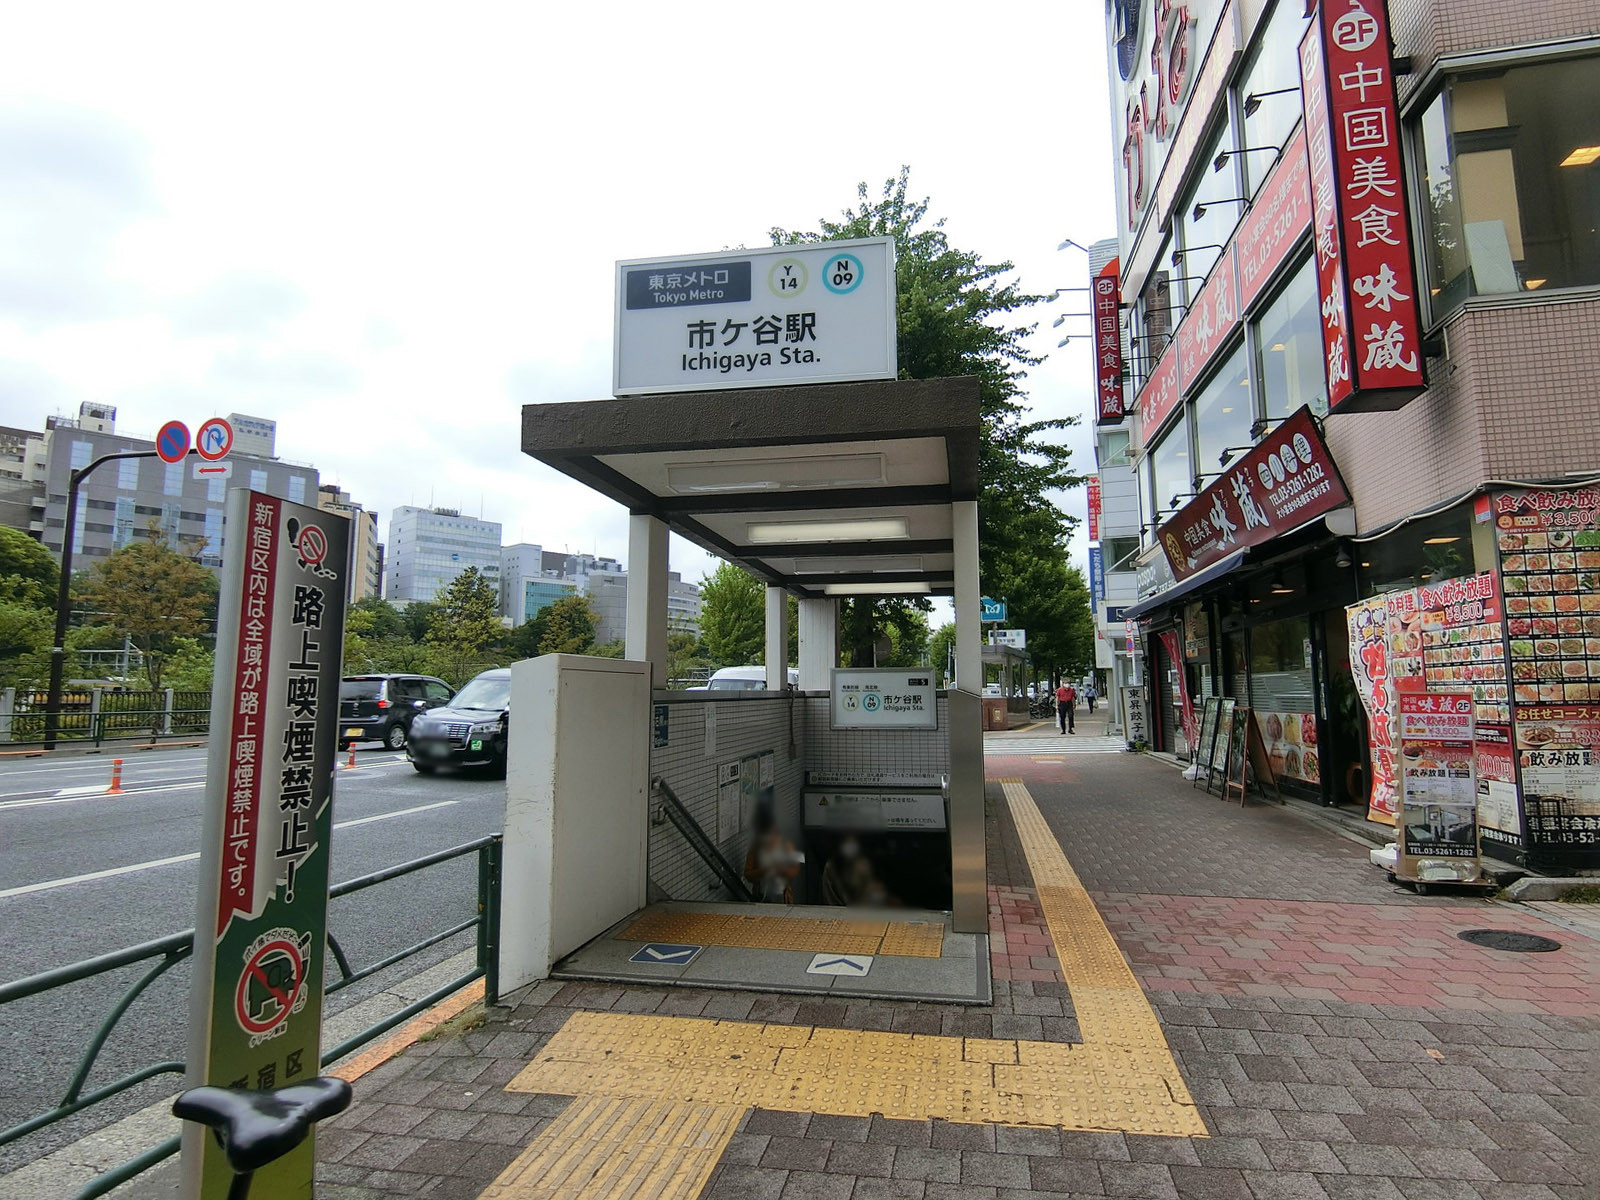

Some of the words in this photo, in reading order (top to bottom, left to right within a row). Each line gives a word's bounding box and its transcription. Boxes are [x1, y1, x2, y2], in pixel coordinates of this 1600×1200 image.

[1338, 19, 1373, 45] 2F
[1338, 62, 1400, 248] 中国美食
[1306, 83, 1337, 271] 中国美食
[783, 265, 793, 276] Y
[836, 260, 849, 272] N
[648, 269, 729, 290] 東京メトロ
[780, 277, 798, 290] 14
[832, 272, 853, 286] 09
[1098, 282, 1113, 292] 2F
[653, 291, 687, 305] Tokyo
[689, 288, 724, 301] Metro
[1196, 269, 1233, 356] 味蔵
[1352, 263, 1418, 372] 味蔵
[1098, 298, 1118, 369] 中国美食
[1321, 279, 1349, 390] 味蔵
[681, 351, 771, 374] Ichigaya
[780, 346, 821, 366] Sta.
[1100, 376, 1123, 415] 味蔵
[1209, 469, 1270, 546] 味蔵
[1498, 489, 1600, 513] 食べ飲み放
[1183, 518, 1213, 548] 中国美食
[1421, 574, 1493, 610] 食べ飲み放題
[228, 502, 273, 897] 新宿区内は全域が路上喫煙禁止です。
[883, 704, 911, 712] Ichigaya
[1417, 696, 1457, 714] 味蔵
[1457, 702, 1469, 711] 2F
[1405, 714, 1470, 727] 食べ飲み放題
[1410, 768, 1446, 778] 飲み放題
[1409, 846, 1474, 857] TEL.03-5261-1282
